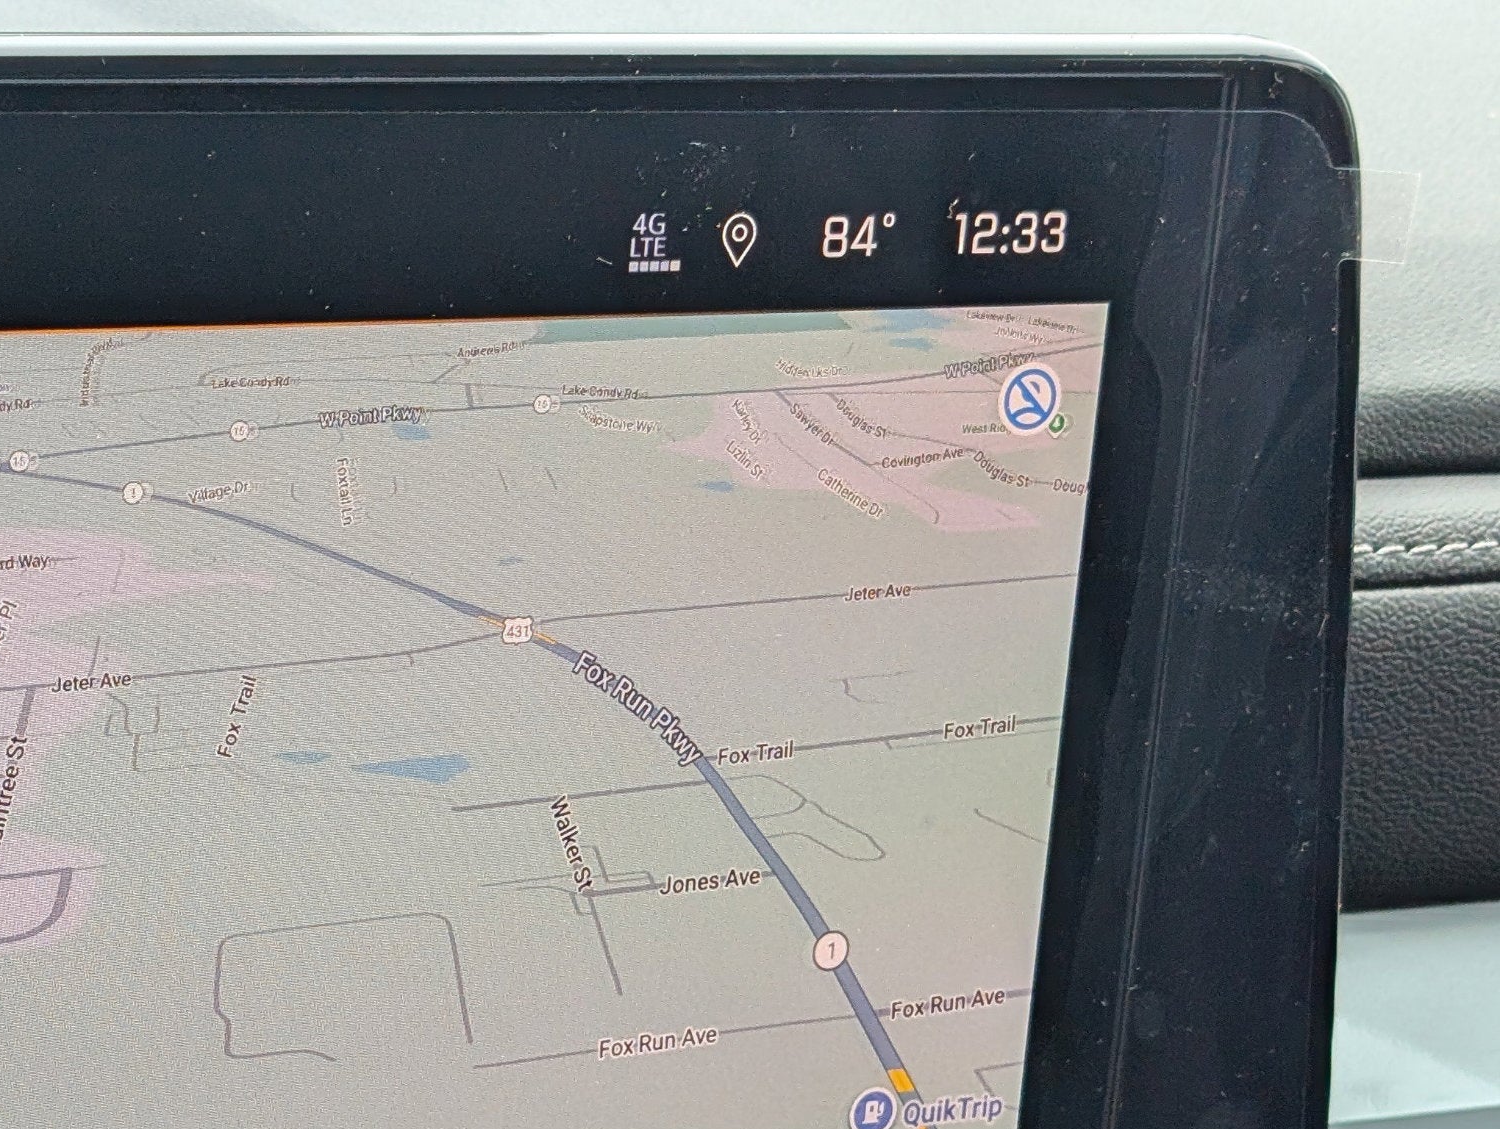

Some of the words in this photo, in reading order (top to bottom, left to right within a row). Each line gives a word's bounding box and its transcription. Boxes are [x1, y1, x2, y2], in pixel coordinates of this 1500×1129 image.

[633, 213, 665, 236] 4G
[955, 211, 1067, 255] 12:33
[629, 237, 667, 258] LTE
[944, 365, 959, 379] W
[961, 356, 996, 376] Point
[212, 378, 238, 389] Lake
[273, 376, 291, 387] Rd
[562, 384, 587, 396] Lake
[624, 388, 639, 400] Rd
[15, 398, 33, 410] Rd
[319, 411, 336, 429] W
[337, 408, 380, 427] Point
[381, 404, 422, 424] Pkwy
[790, 403, 824, 437] Sawyer
[821, 431, 834, 447] Dr
[837, 399, 873, 434] Douglas
[874, 426, 888, 439] St
[882, 454, 941, 469] Covington
[943, 448, 964, 460] Ave
[973, 451, 1015, 484] Douglas
[1016, 475, 1030, 488] St
[336, 457, 352, 505] Foxtail
[750, 464, 764, 479] St
[189, 484, 232, 503] Village
[234, 481, 249, 494] Dr
[818, 468, 869, 512] Catherine
[868, 503, 884, 518] Dr
[1053, 478, 1087, 496] Doug
[340, 506, 354, 526] Ln
[18, 555, 50, 571] Way
[845, 586, 882, 602] Jeter
[885, 583, 911, 598] Ave
[507, 624, 530, 639] 431
[51, 676, 95, 693] Jeter
[99, 672, 132, 690] Ave
[216, 720, 242, 758] Fox
[230, 674, 257, 716] Trail
[573, 650, 616, 692] Fox
[611, 675, 657, 720] Run
[650, 706, 703, 767] Pkwy
[944, 722, 975, 740] Fox
[981, 714, 1017, 736] Trail
[5, 735, 28, 760] St
[717, 748, 750, 766] Fox
[756, 740, 794, 762] Trail
[550, 794, 583, 865] Walker
[573, 866, 593, 893] St
[659, 875, 719, 895] Jones
[725, 868, 761, 888] Ave
[828, 942, 837, 960] 1
[890, 1002, 925, 1020] Fox
[930, 995, 966, 1015] Run
[971, 989, 1006, 1008] Ave
[598, 1039, 635, 1060] Fox
[638, 1032, 677, 1053] Run
[680, 1028, 718, 1047] Ave
[903, 1095, 1002, 1127] QuikTrip
